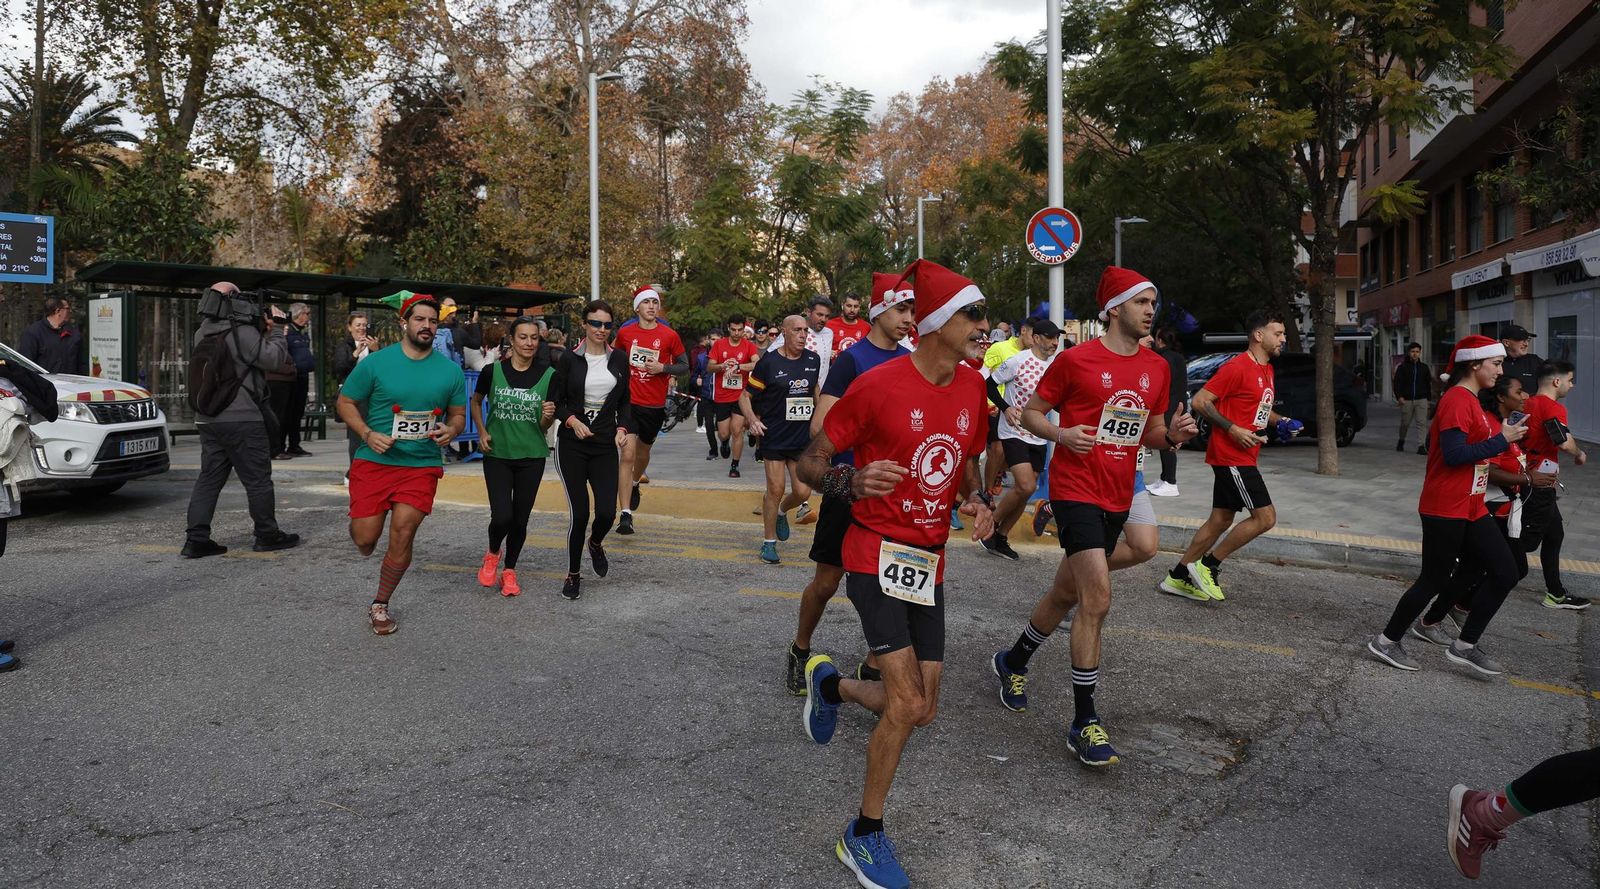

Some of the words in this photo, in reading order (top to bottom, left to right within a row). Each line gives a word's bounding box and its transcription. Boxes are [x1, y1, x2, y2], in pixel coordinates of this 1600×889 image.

[36, 235, 46, 243] 2m
[36, 245, 46, 253] 8m
[1028, 242, 1062, 263] EXCEPTO
[1063, 242, 1079, 259] BUS
[29, 255, 46, 263] +30m
[789, 406, 811, 415] 413
[397, 421, 430, 432] 231
[1103, 419, 1140, 436] 486
[127, 441, 144, 453] 1315
[910, 441, 927, 470] CARRERA
[884, 563, 929, 590] 487
